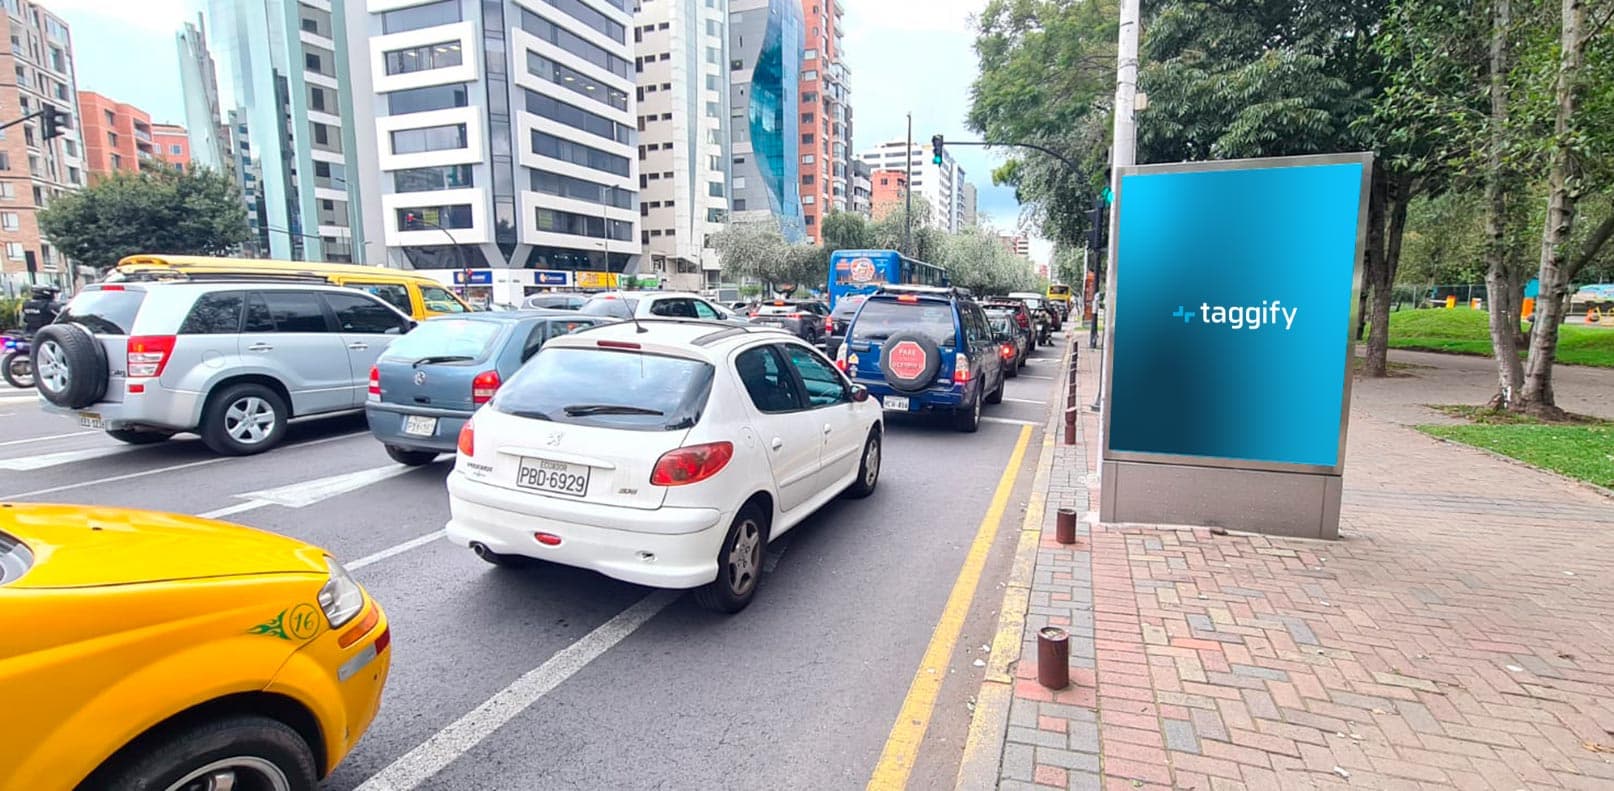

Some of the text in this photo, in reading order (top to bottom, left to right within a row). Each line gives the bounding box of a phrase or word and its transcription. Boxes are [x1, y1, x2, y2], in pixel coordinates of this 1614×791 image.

[1200, 300, 1298, 330] taggify
[519, 467, 585, 492] PBD-6929
[295, 611, 313, 632] 16
